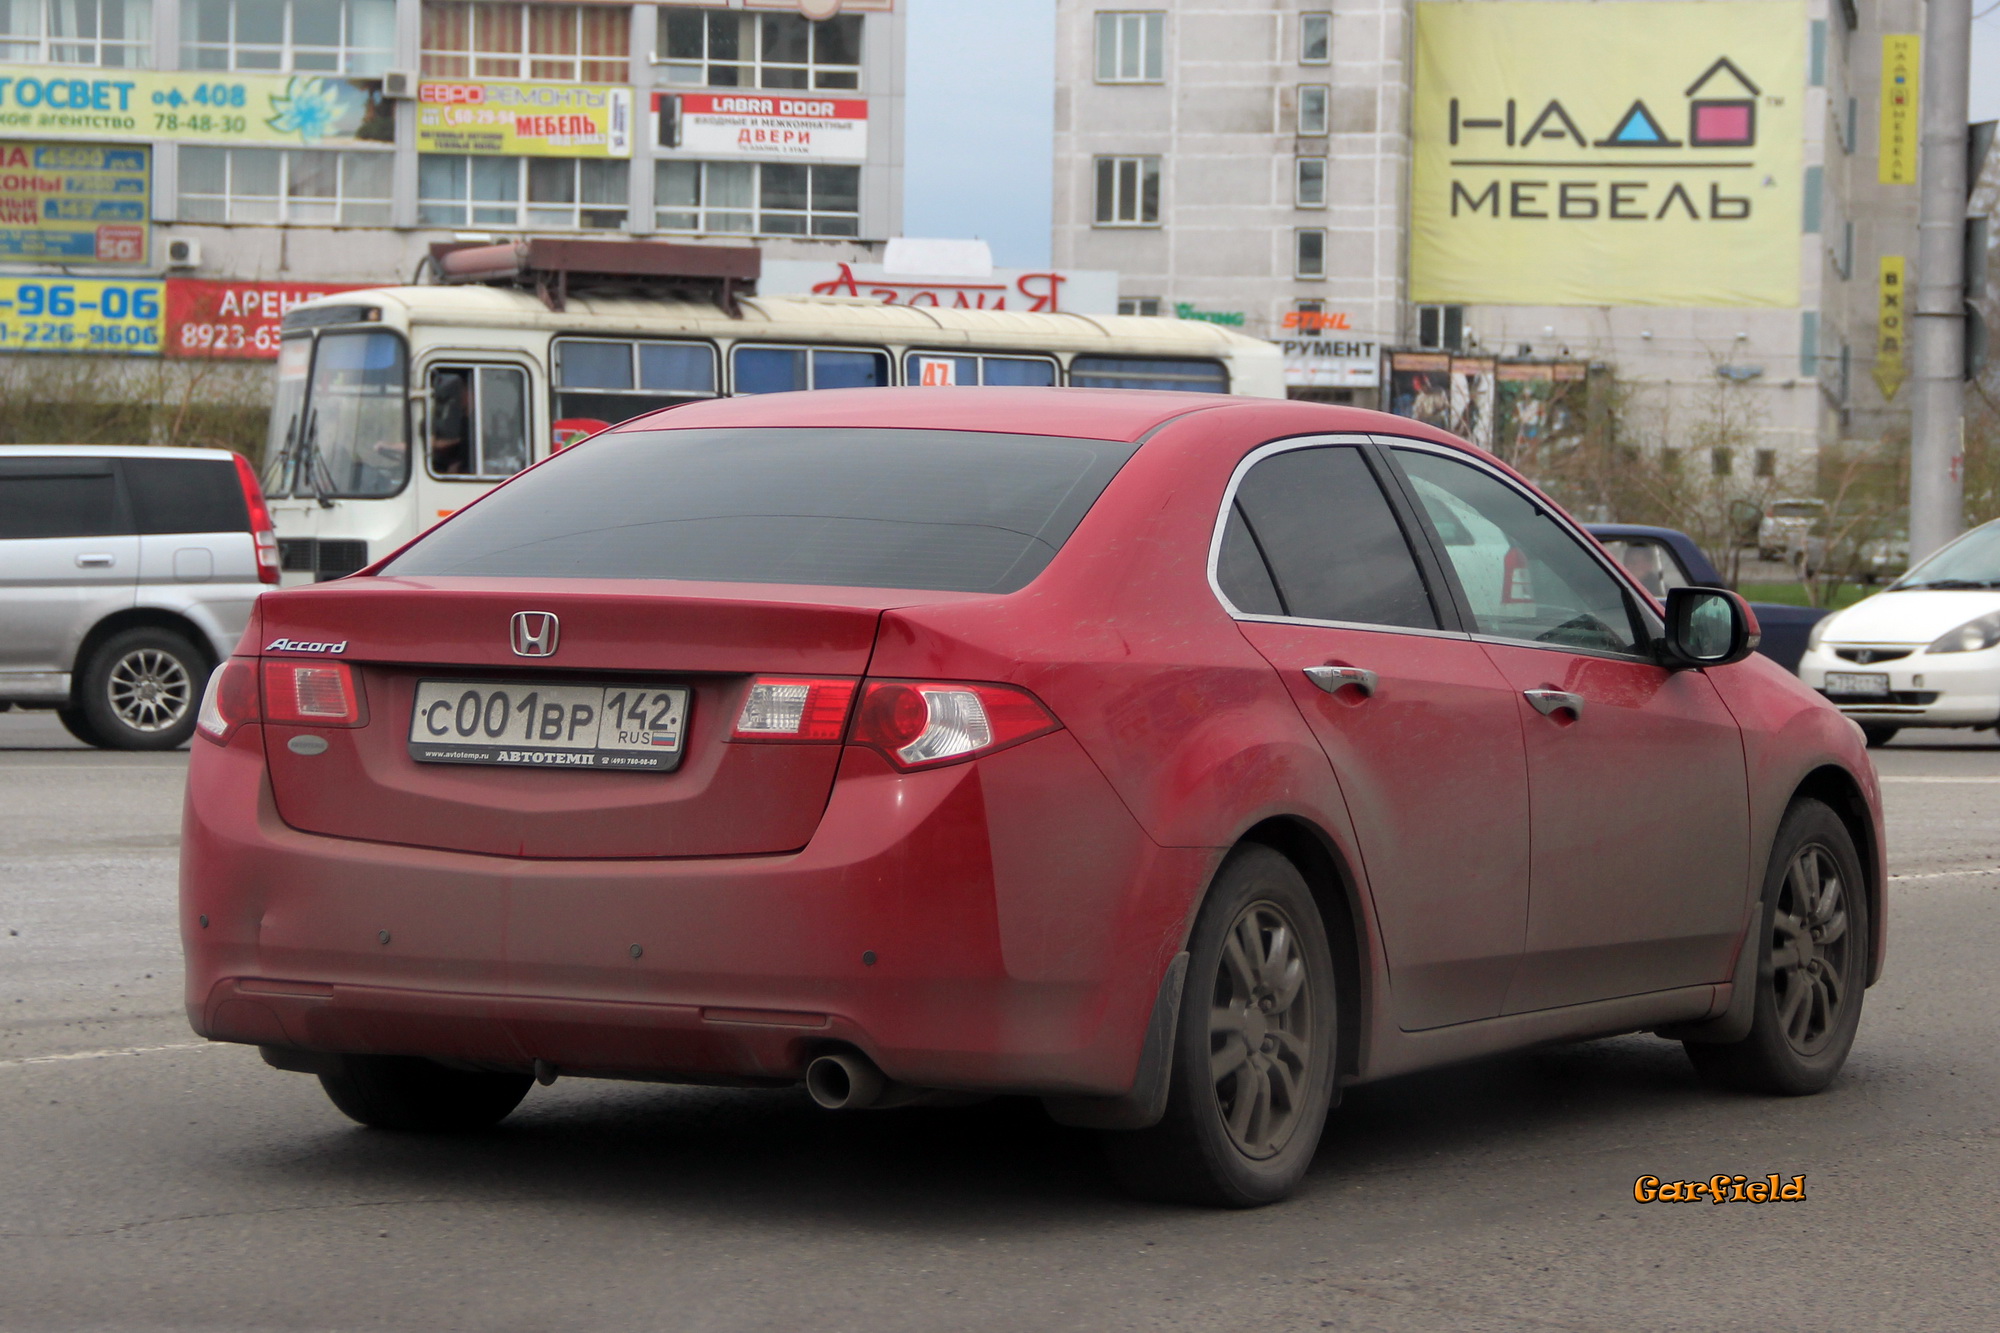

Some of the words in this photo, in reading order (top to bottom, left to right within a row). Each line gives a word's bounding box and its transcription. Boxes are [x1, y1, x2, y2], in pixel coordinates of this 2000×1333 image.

[193, 83, 246, 107] 408
[712, 97, 773, 114] LABRA
[779, 101, 835, 116] DOOR
[154, 113, 247, 134] 78-48-30
[516, 115, 597, 137] МЕБЕЛЬ
[761, 119, 853, 131] МЕЖКОМНАТНЫЕ
[737, 128, 811, 144] ДВЕРИ
[0, 176, 62, 192] ОНЫ
[1450, 179, 1752, 220] МЕБЕЛЬ
[1281, 312, 1351, 330] STIHL
[265, 638, 347, 654] Accord
[426, 690, 594, 742] С001ВР
[607, 691, 668, 731] 142
[618, 730, 650, 745] RUS
[425, 751, 490, 760] www.avtotemp.ru
[497, 750, 595, 766] АВТОТЕМП
